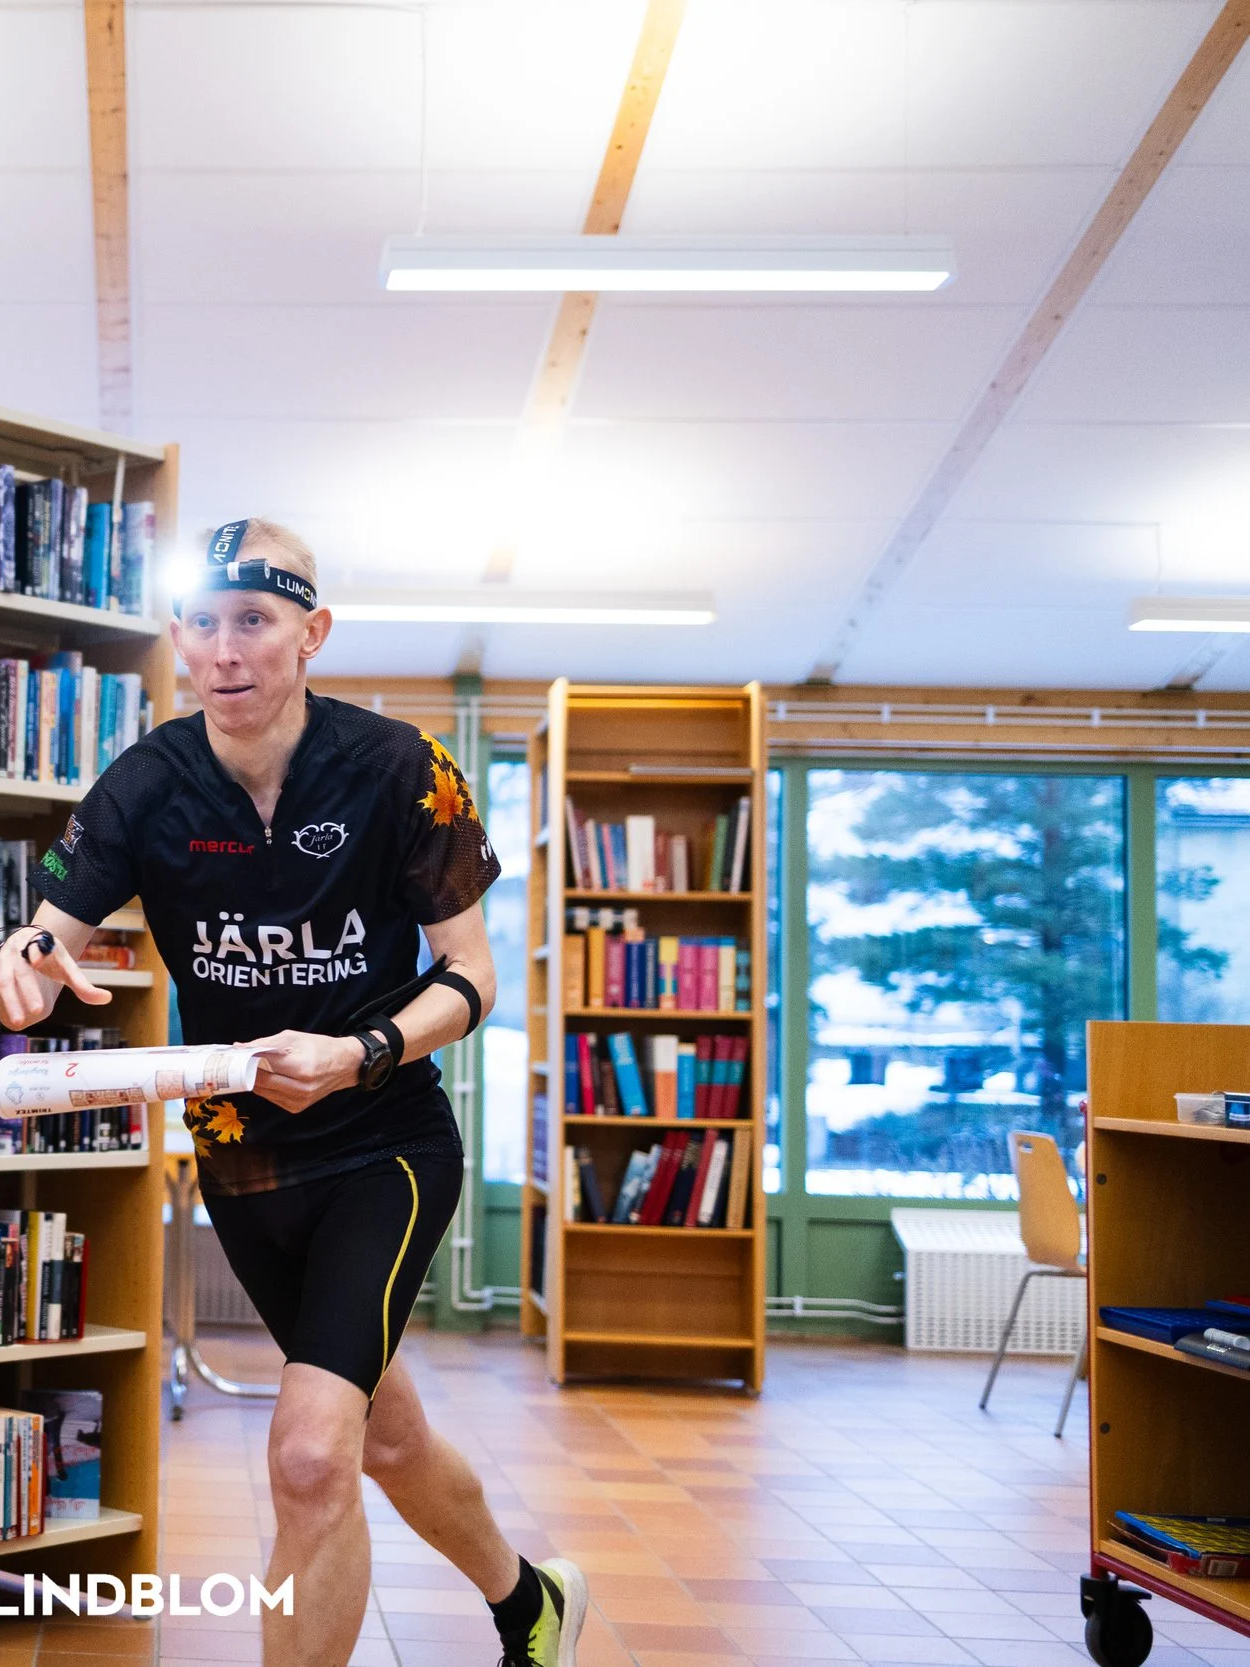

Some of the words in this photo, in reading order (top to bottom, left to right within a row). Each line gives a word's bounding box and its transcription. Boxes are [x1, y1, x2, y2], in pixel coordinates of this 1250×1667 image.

[193, 908, 366, 965] JÄRLA
[193, 952, 367, 987] ORIENTERING
[65, 1062, 78, 1077] 2
[15, 1107, 52, 1116] TRIMTEX
